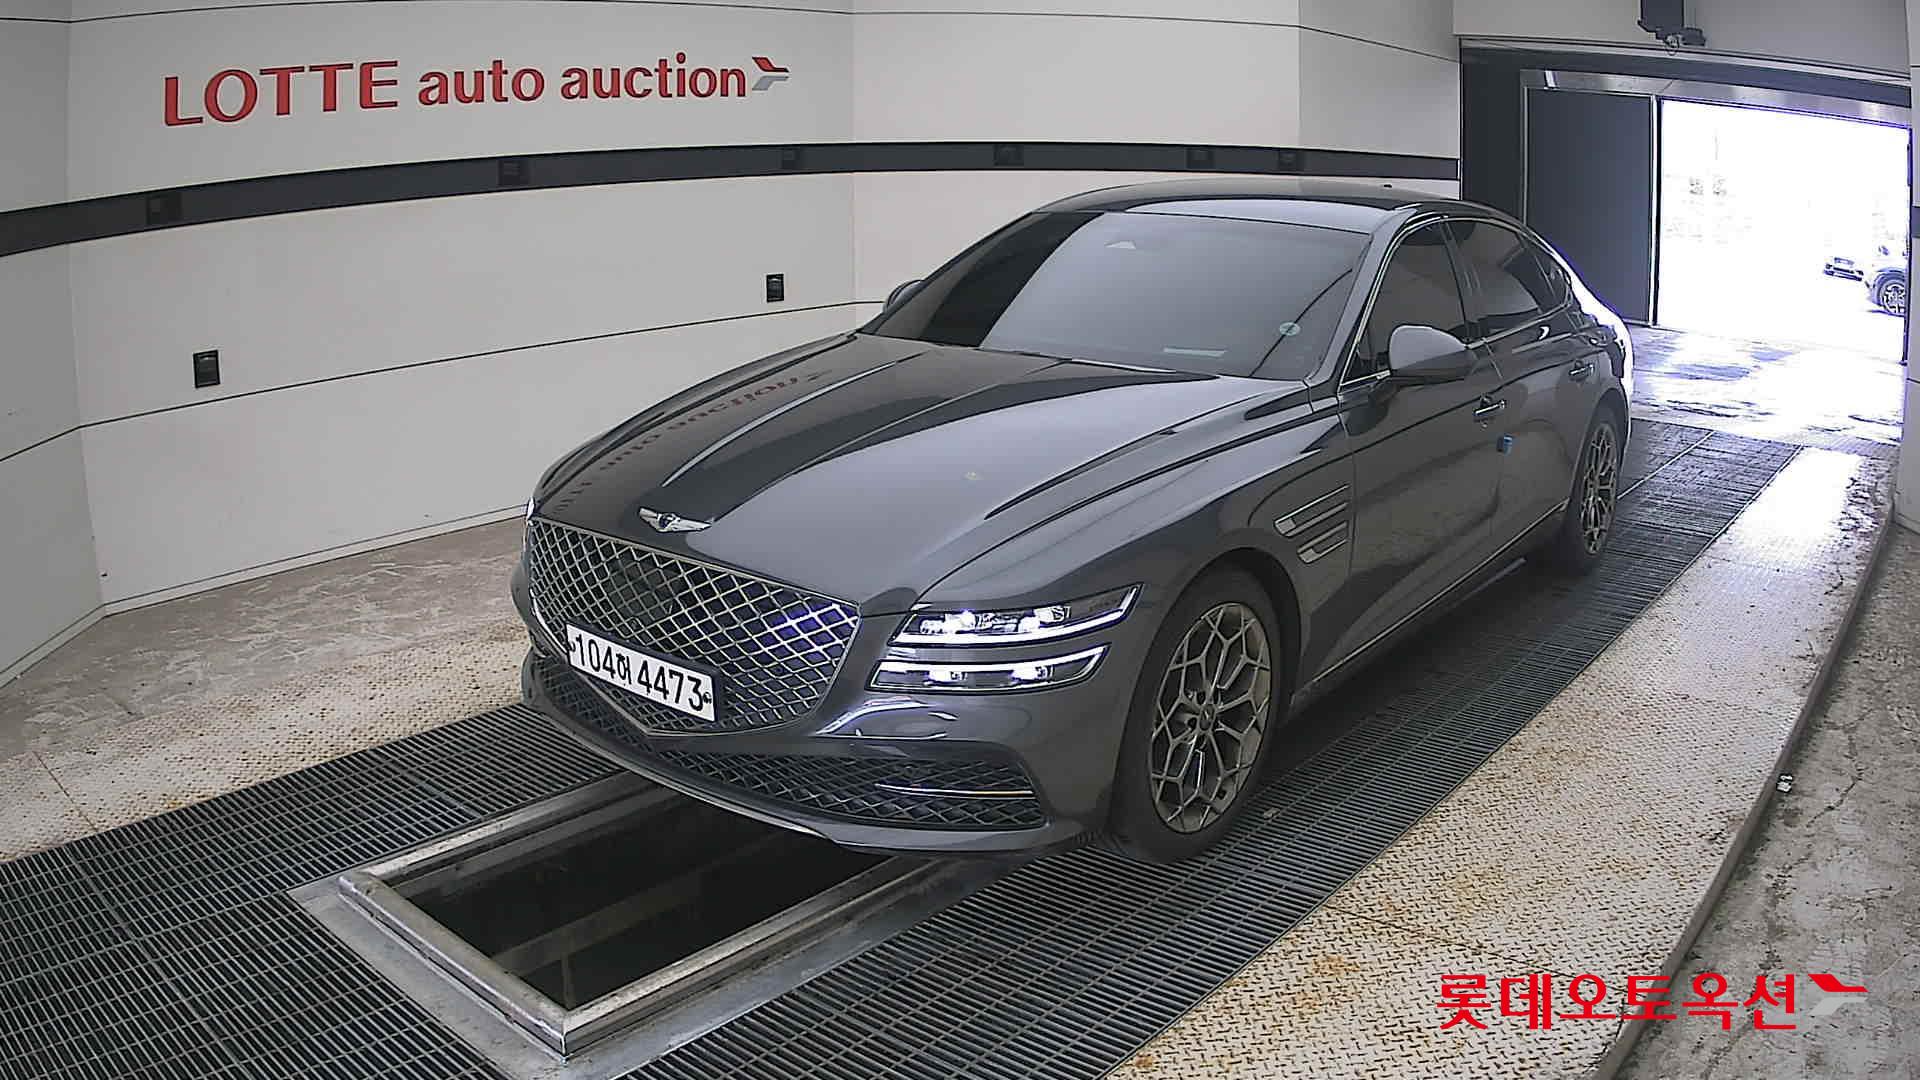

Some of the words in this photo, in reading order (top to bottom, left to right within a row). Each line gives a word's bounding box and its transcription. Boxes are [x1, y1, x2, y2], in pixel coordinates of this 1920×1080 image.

[164, 60, 399, 126] LOTTE
[417, 58, 545, 106] auto
[560, 52, 747, 99] auction
[637, 660, 704, 712] 4473
